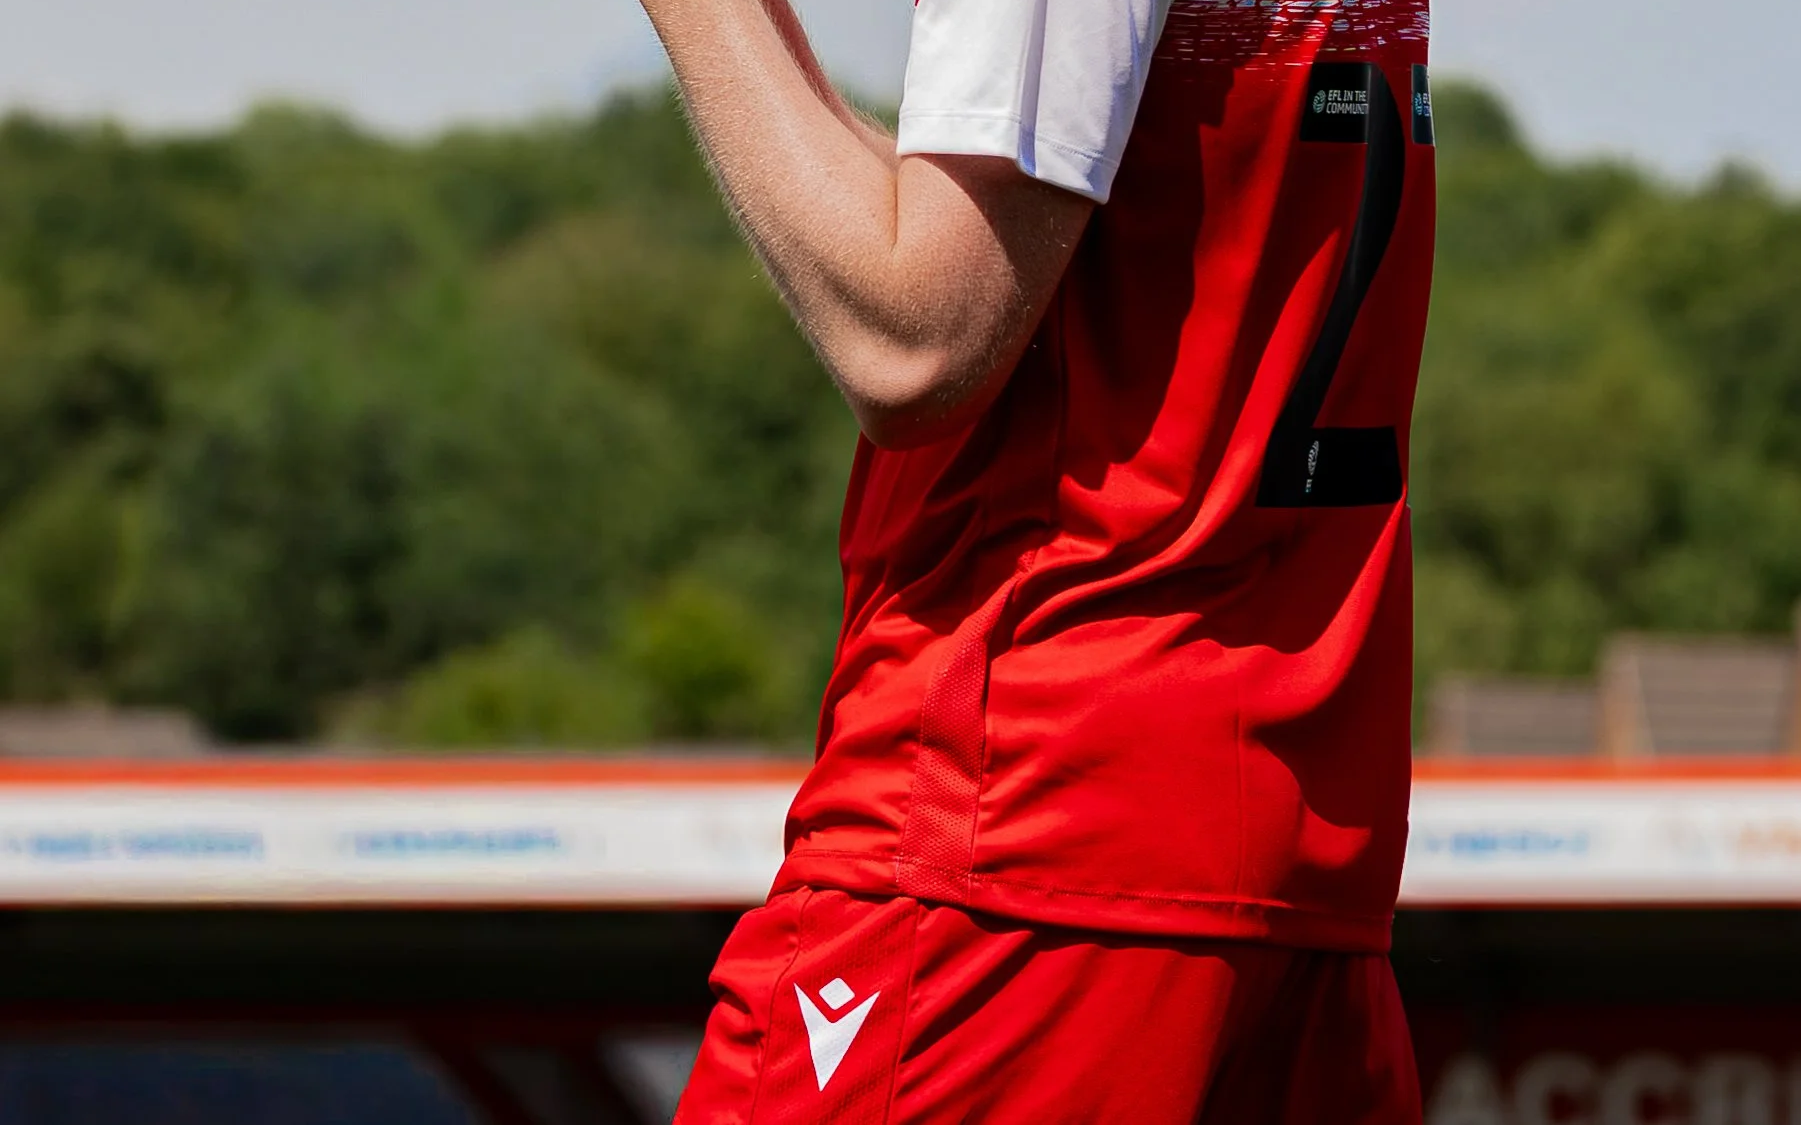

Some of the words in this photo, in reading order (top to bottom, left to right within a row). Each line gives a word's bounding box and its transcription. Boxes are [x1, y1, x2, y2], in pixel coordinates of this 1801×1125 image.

[1328, 89, 1342, 102] EFL
[1343, 89, 1354, 102] IN
[1355, 90, 1367, 102] THE
